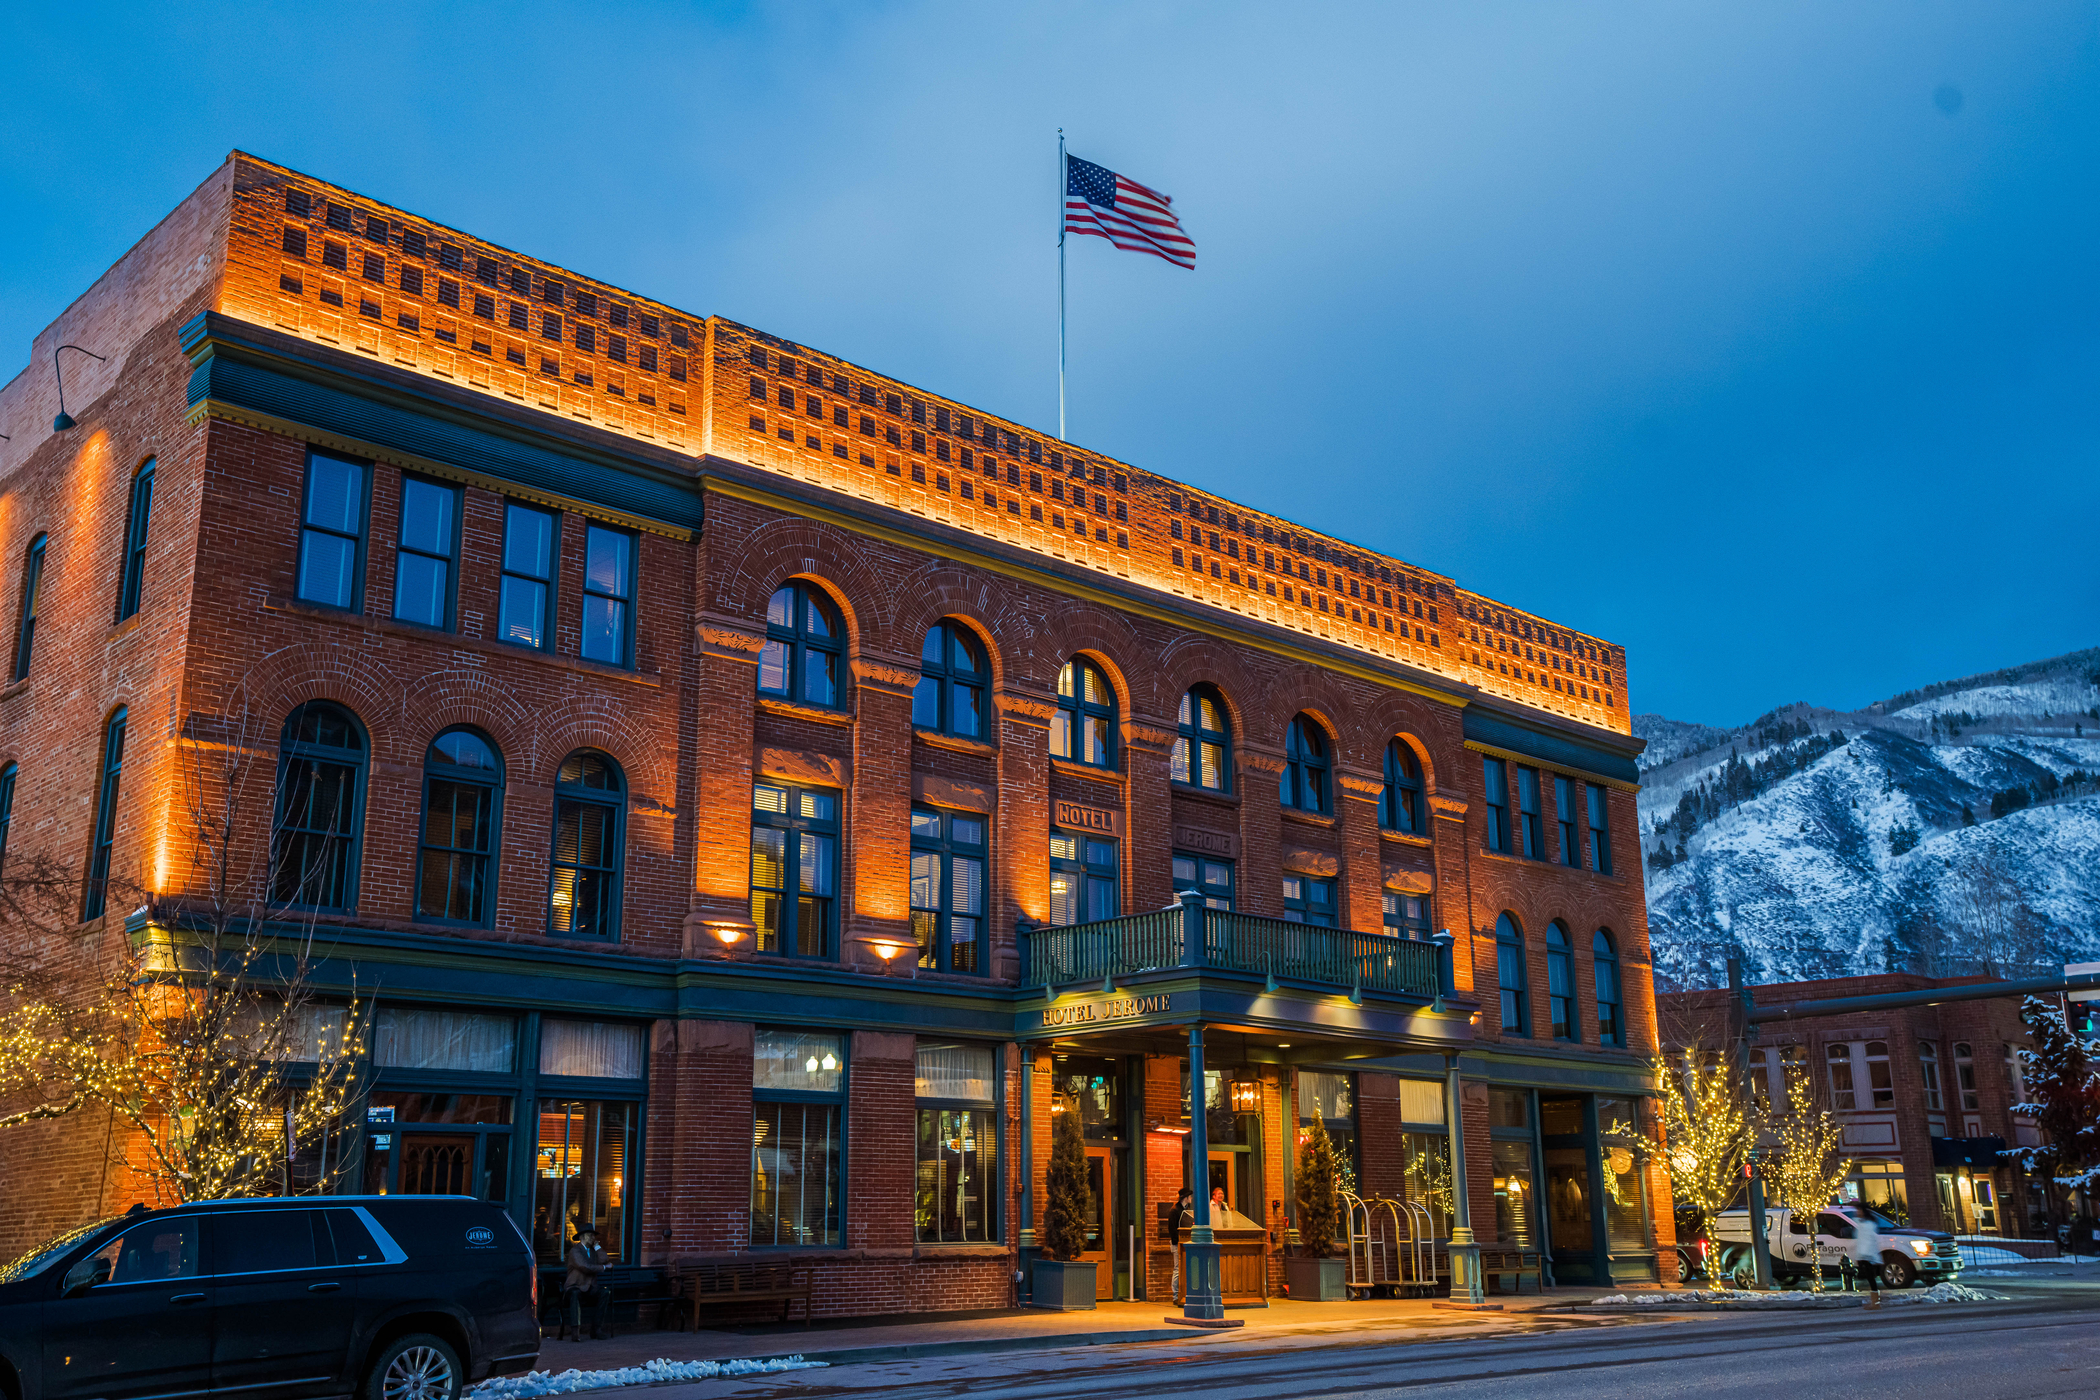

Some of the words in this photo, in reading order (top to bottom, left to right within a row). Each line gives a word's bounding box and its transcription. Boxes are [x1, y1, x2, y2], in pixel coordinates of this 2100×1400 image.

[1059, 803, 1112, 830] HOTEL
[1177, 830, 1231, 852] JEROME
[1042, 1005, 1095, 1025] HOTEL
[1101, 995, 1170, 1018] JEROME
[1806, 1244, 1847, 1253] Pragon
